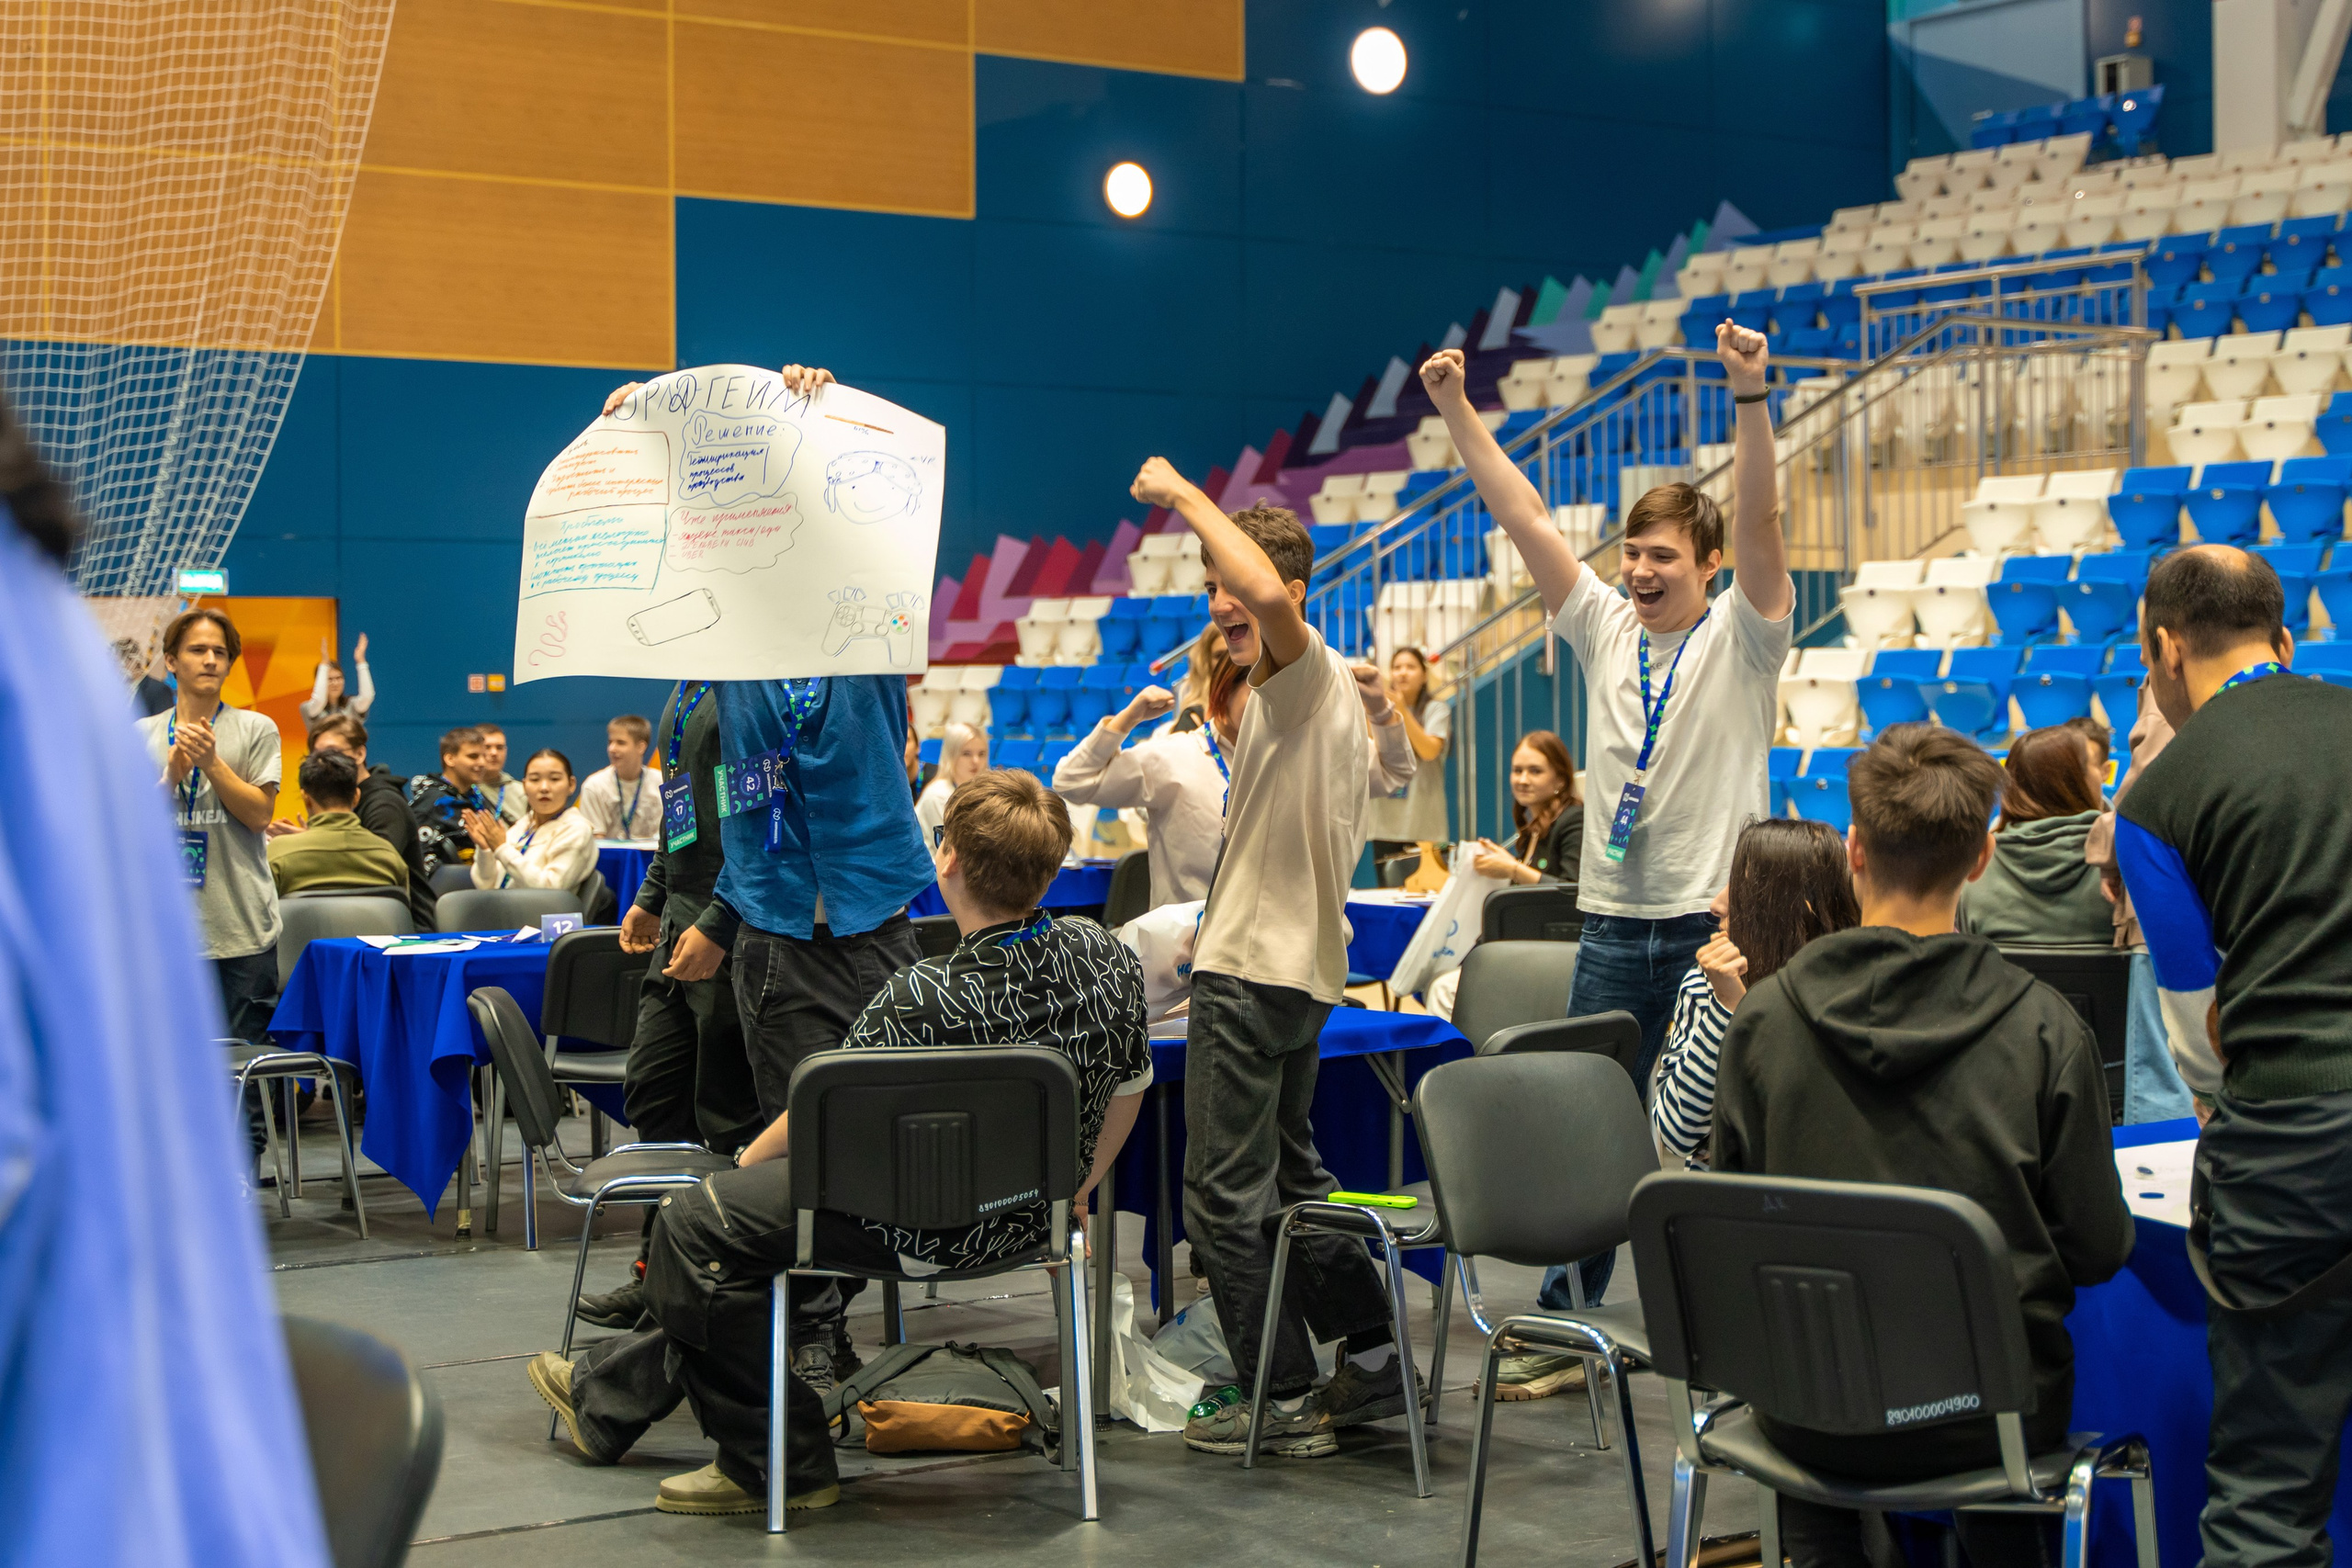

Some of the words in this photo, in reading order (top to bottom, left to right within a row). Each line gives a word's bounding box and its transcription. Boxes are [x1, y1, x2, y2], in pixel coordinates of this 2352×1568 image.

[717, 770, 728, 814] УЧАСТНИК
[746, 776, 755, 792] 42
[675, 805, 684, 816] 17
[670, 831, 695, 849] УЧАСТНИК
[552, 919, 573, 934] 12
[1887, 1394, 1981, 1426] 890100004900
